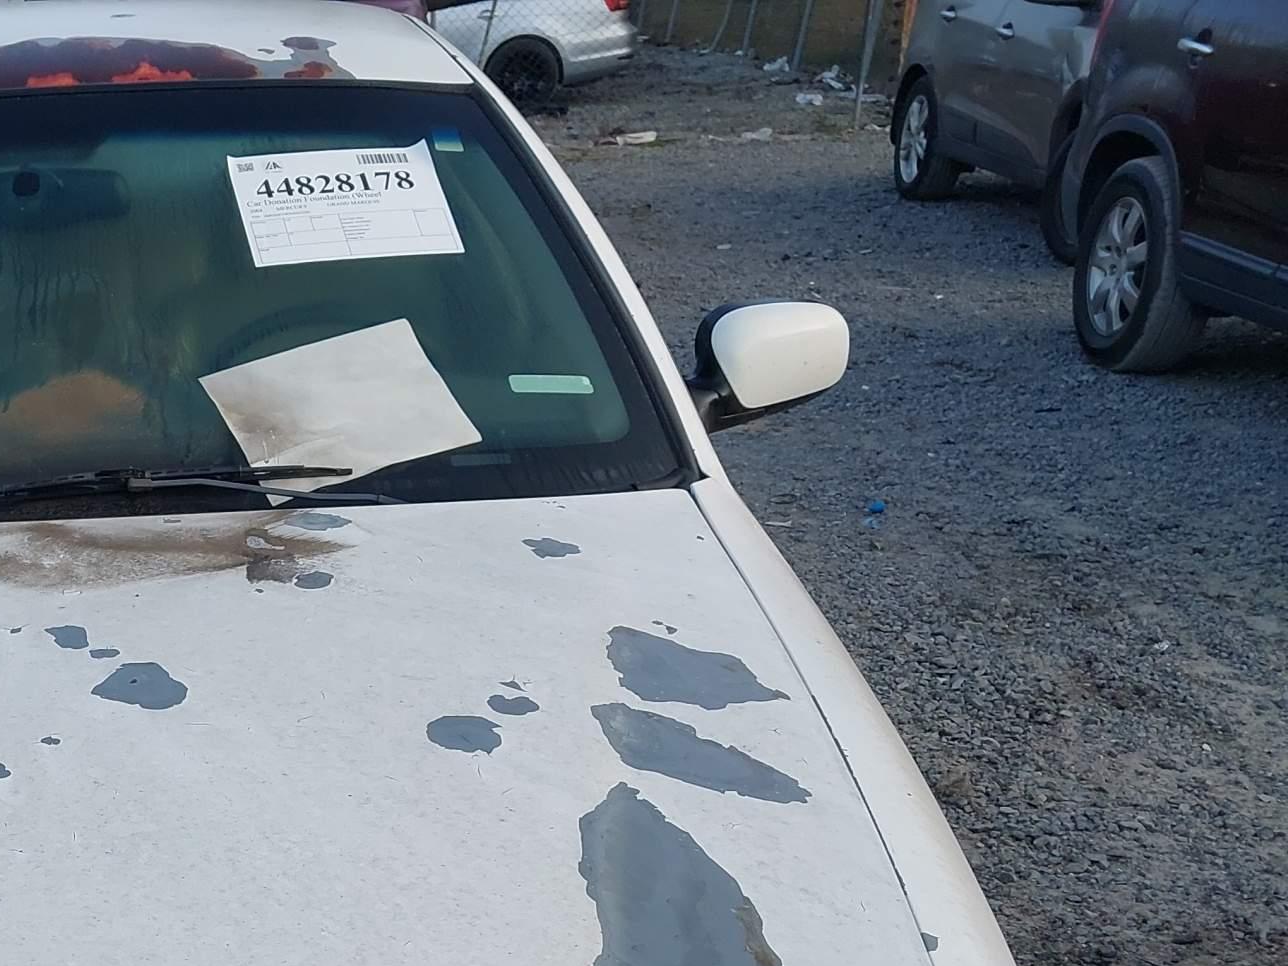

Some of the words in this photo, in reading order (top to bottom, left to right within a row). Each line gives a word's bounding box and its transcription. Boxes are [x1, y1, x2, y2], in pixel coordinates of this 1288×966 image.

[256, 170, 415, 198] 44828178
[246, 200, 262, 208] Car
[264, 198, 303, 206] Donation
[304, 193, 350, 203] Foundation
